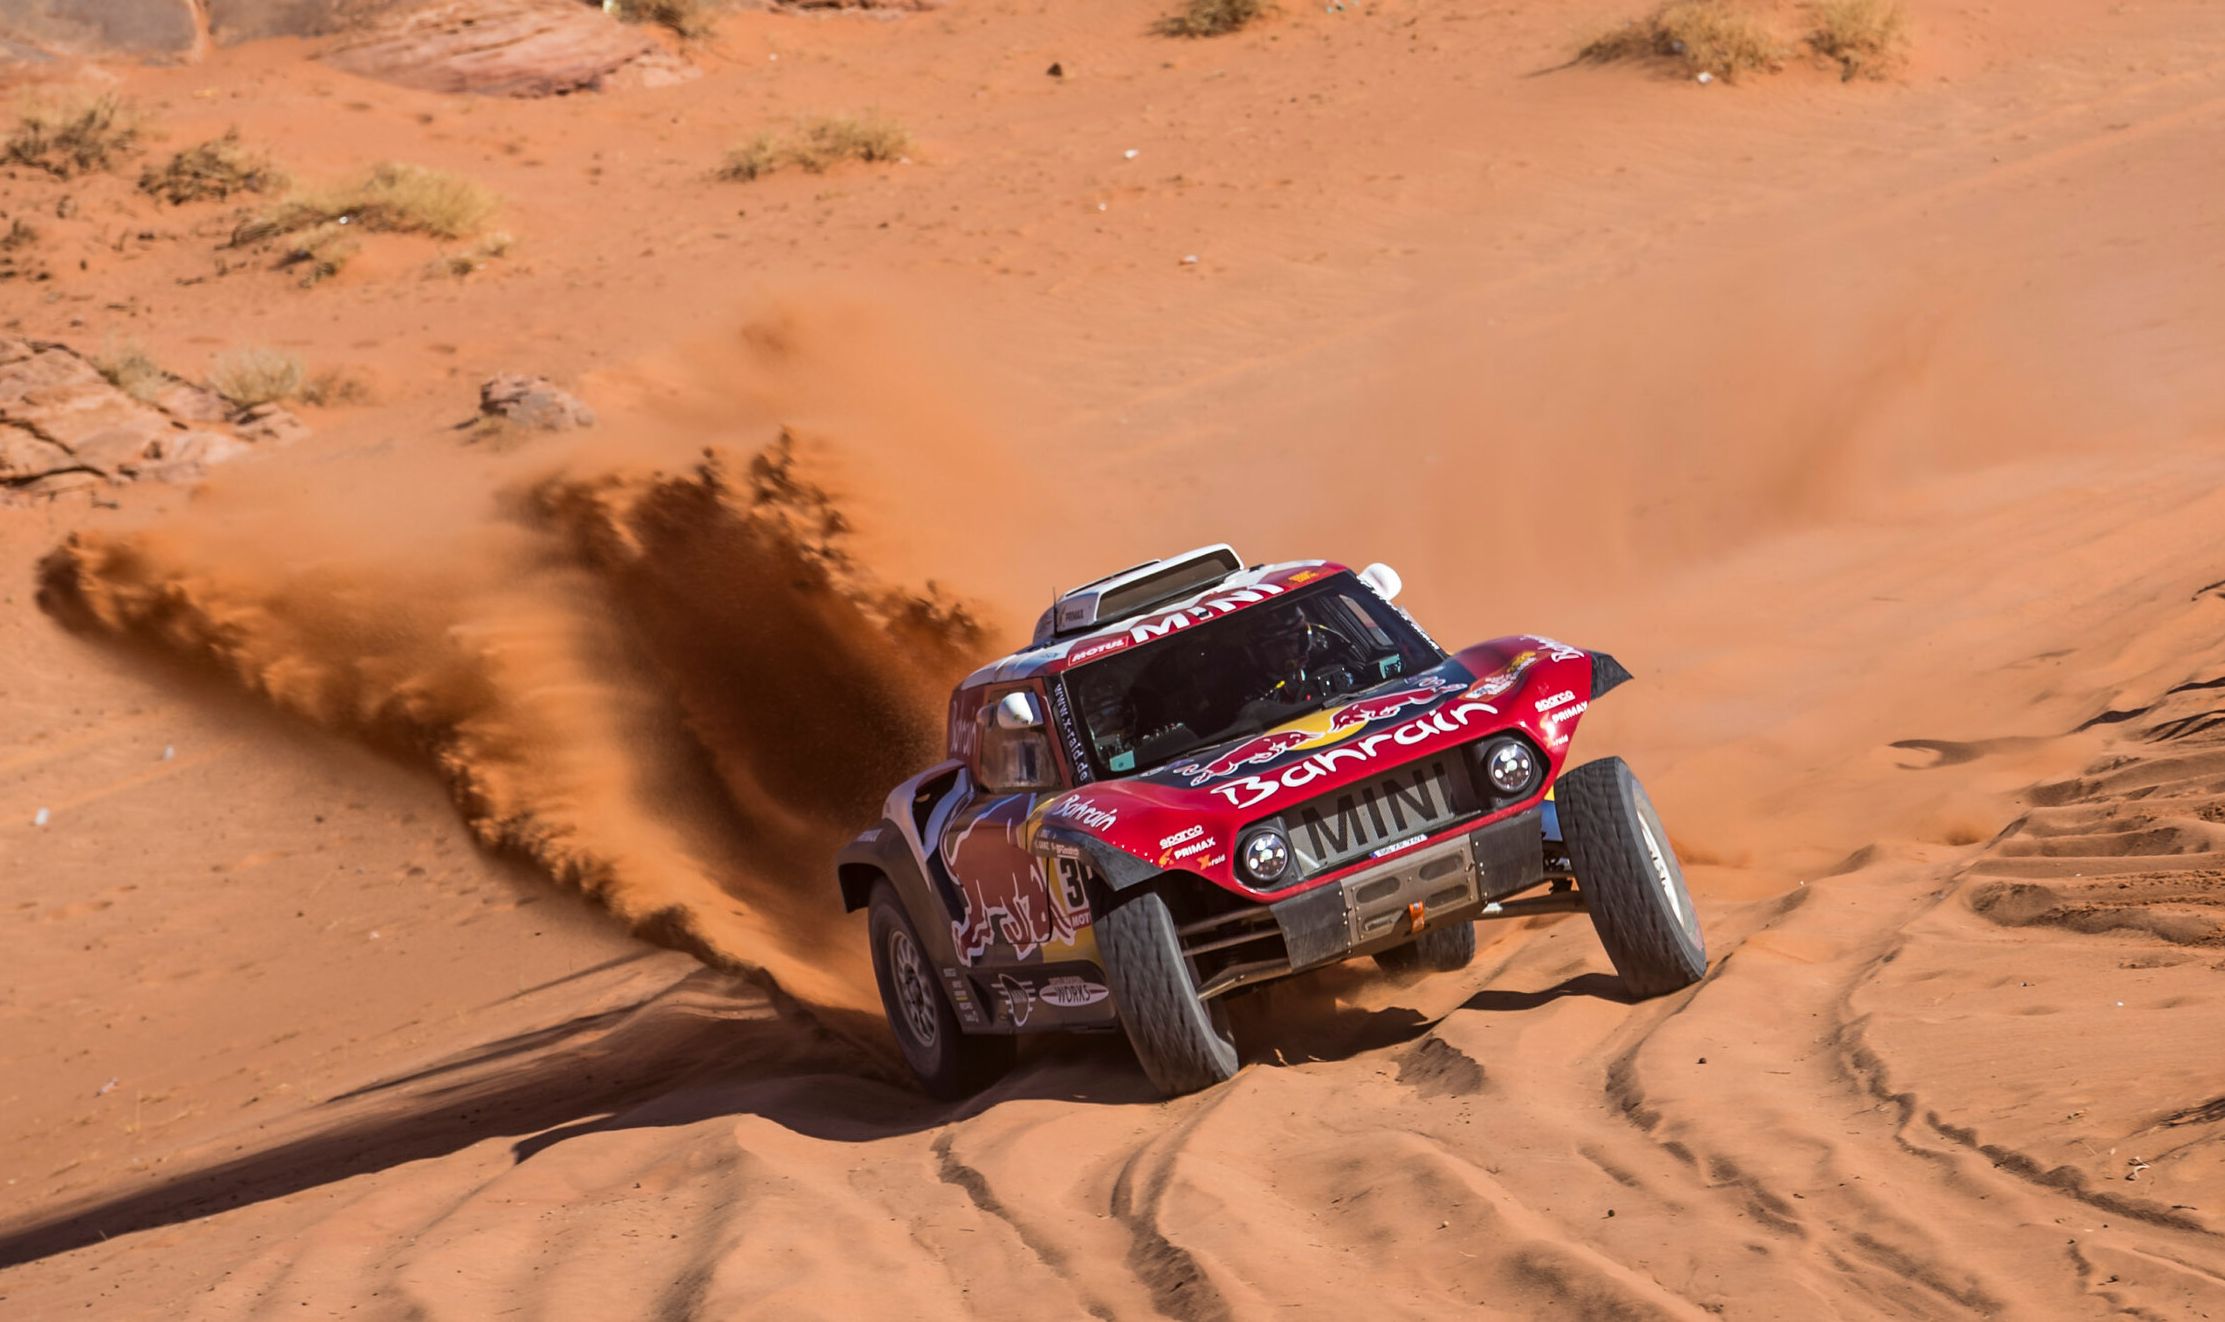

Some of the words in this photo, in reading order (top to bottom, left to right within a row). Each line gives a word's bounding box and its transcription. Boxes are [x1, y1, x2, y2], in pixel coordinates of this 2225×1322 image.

[1129, 583, 1285, 643] MINI
[1071, 639, 1125, 662] MOTUL
[1534, 690, 1576, 712] sparco
[1053, 683, 1089, 782] www.x-raid.de
[1210, 702, 1499, 809] Bahrain
[1051, 793, 1119, 832] Bahrain
[1300, 762, 1458, 861] MINI
[1159, 825, 1204, 849] sparco
[1173, 836, 1217, 860] PRIMAX
[1071, 911, 1092, 928] MOT
[1055, 984, 1091, 1003] WORKS
